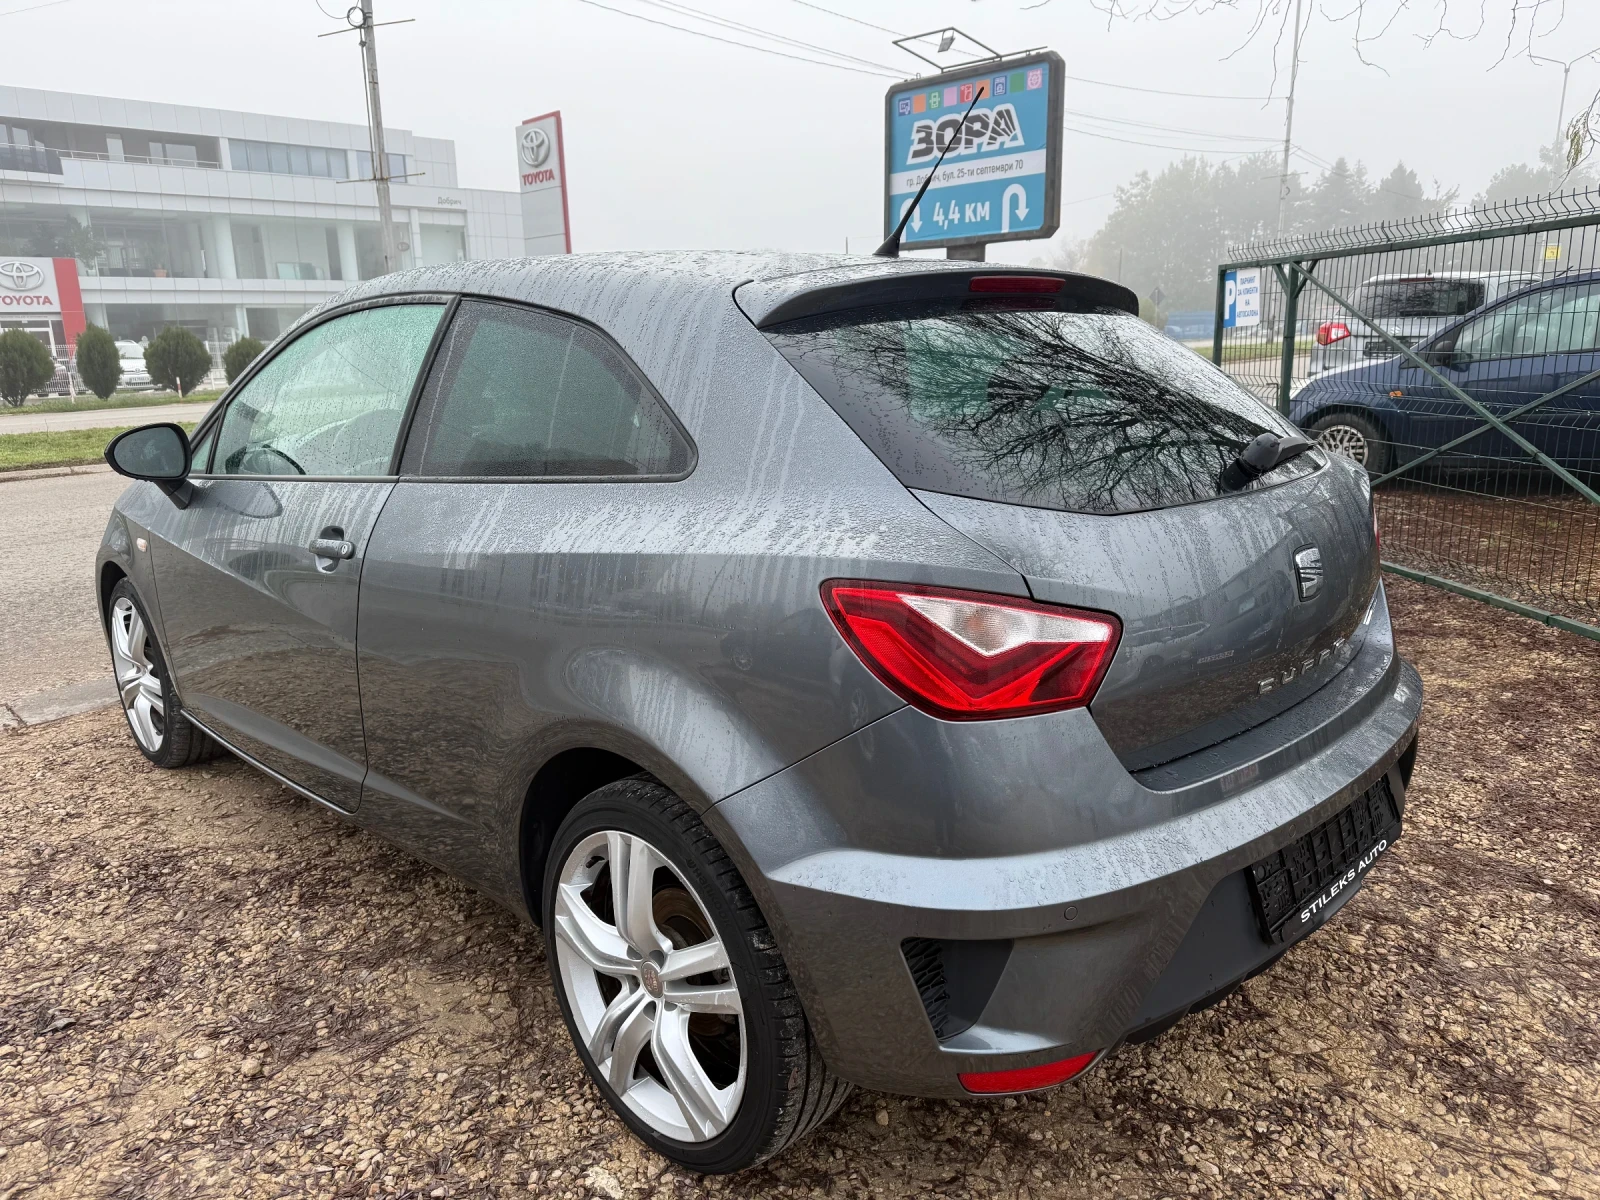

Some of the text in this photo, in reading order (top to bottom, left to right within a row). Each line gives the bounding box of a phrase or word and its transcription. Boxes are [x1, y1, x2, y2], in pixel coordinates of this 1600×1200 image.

[908, 105, 1021, 162] ЗОРА
[522, 168, 555, 186] TOYOTA
[942, 171, 956, 182] бул.
[957, 168, 974, 179] 25-ти
[976, 163, 1013, 175] септември
[1015, 159, 1024, 170] 70
[437, 196, 462, 206] Добрич
[933, 200, 960, 230] 4,4
[1240, 276, 1256, 285] ПАРКИНГ
[0, 295, 53, 305] OYOTA
[1224, 280, 1236, 320] P
[1237, 310, 1258, 318] АВТОСАЛОНА
[1300, 839, 1387, 923] STILEKS AUTO
